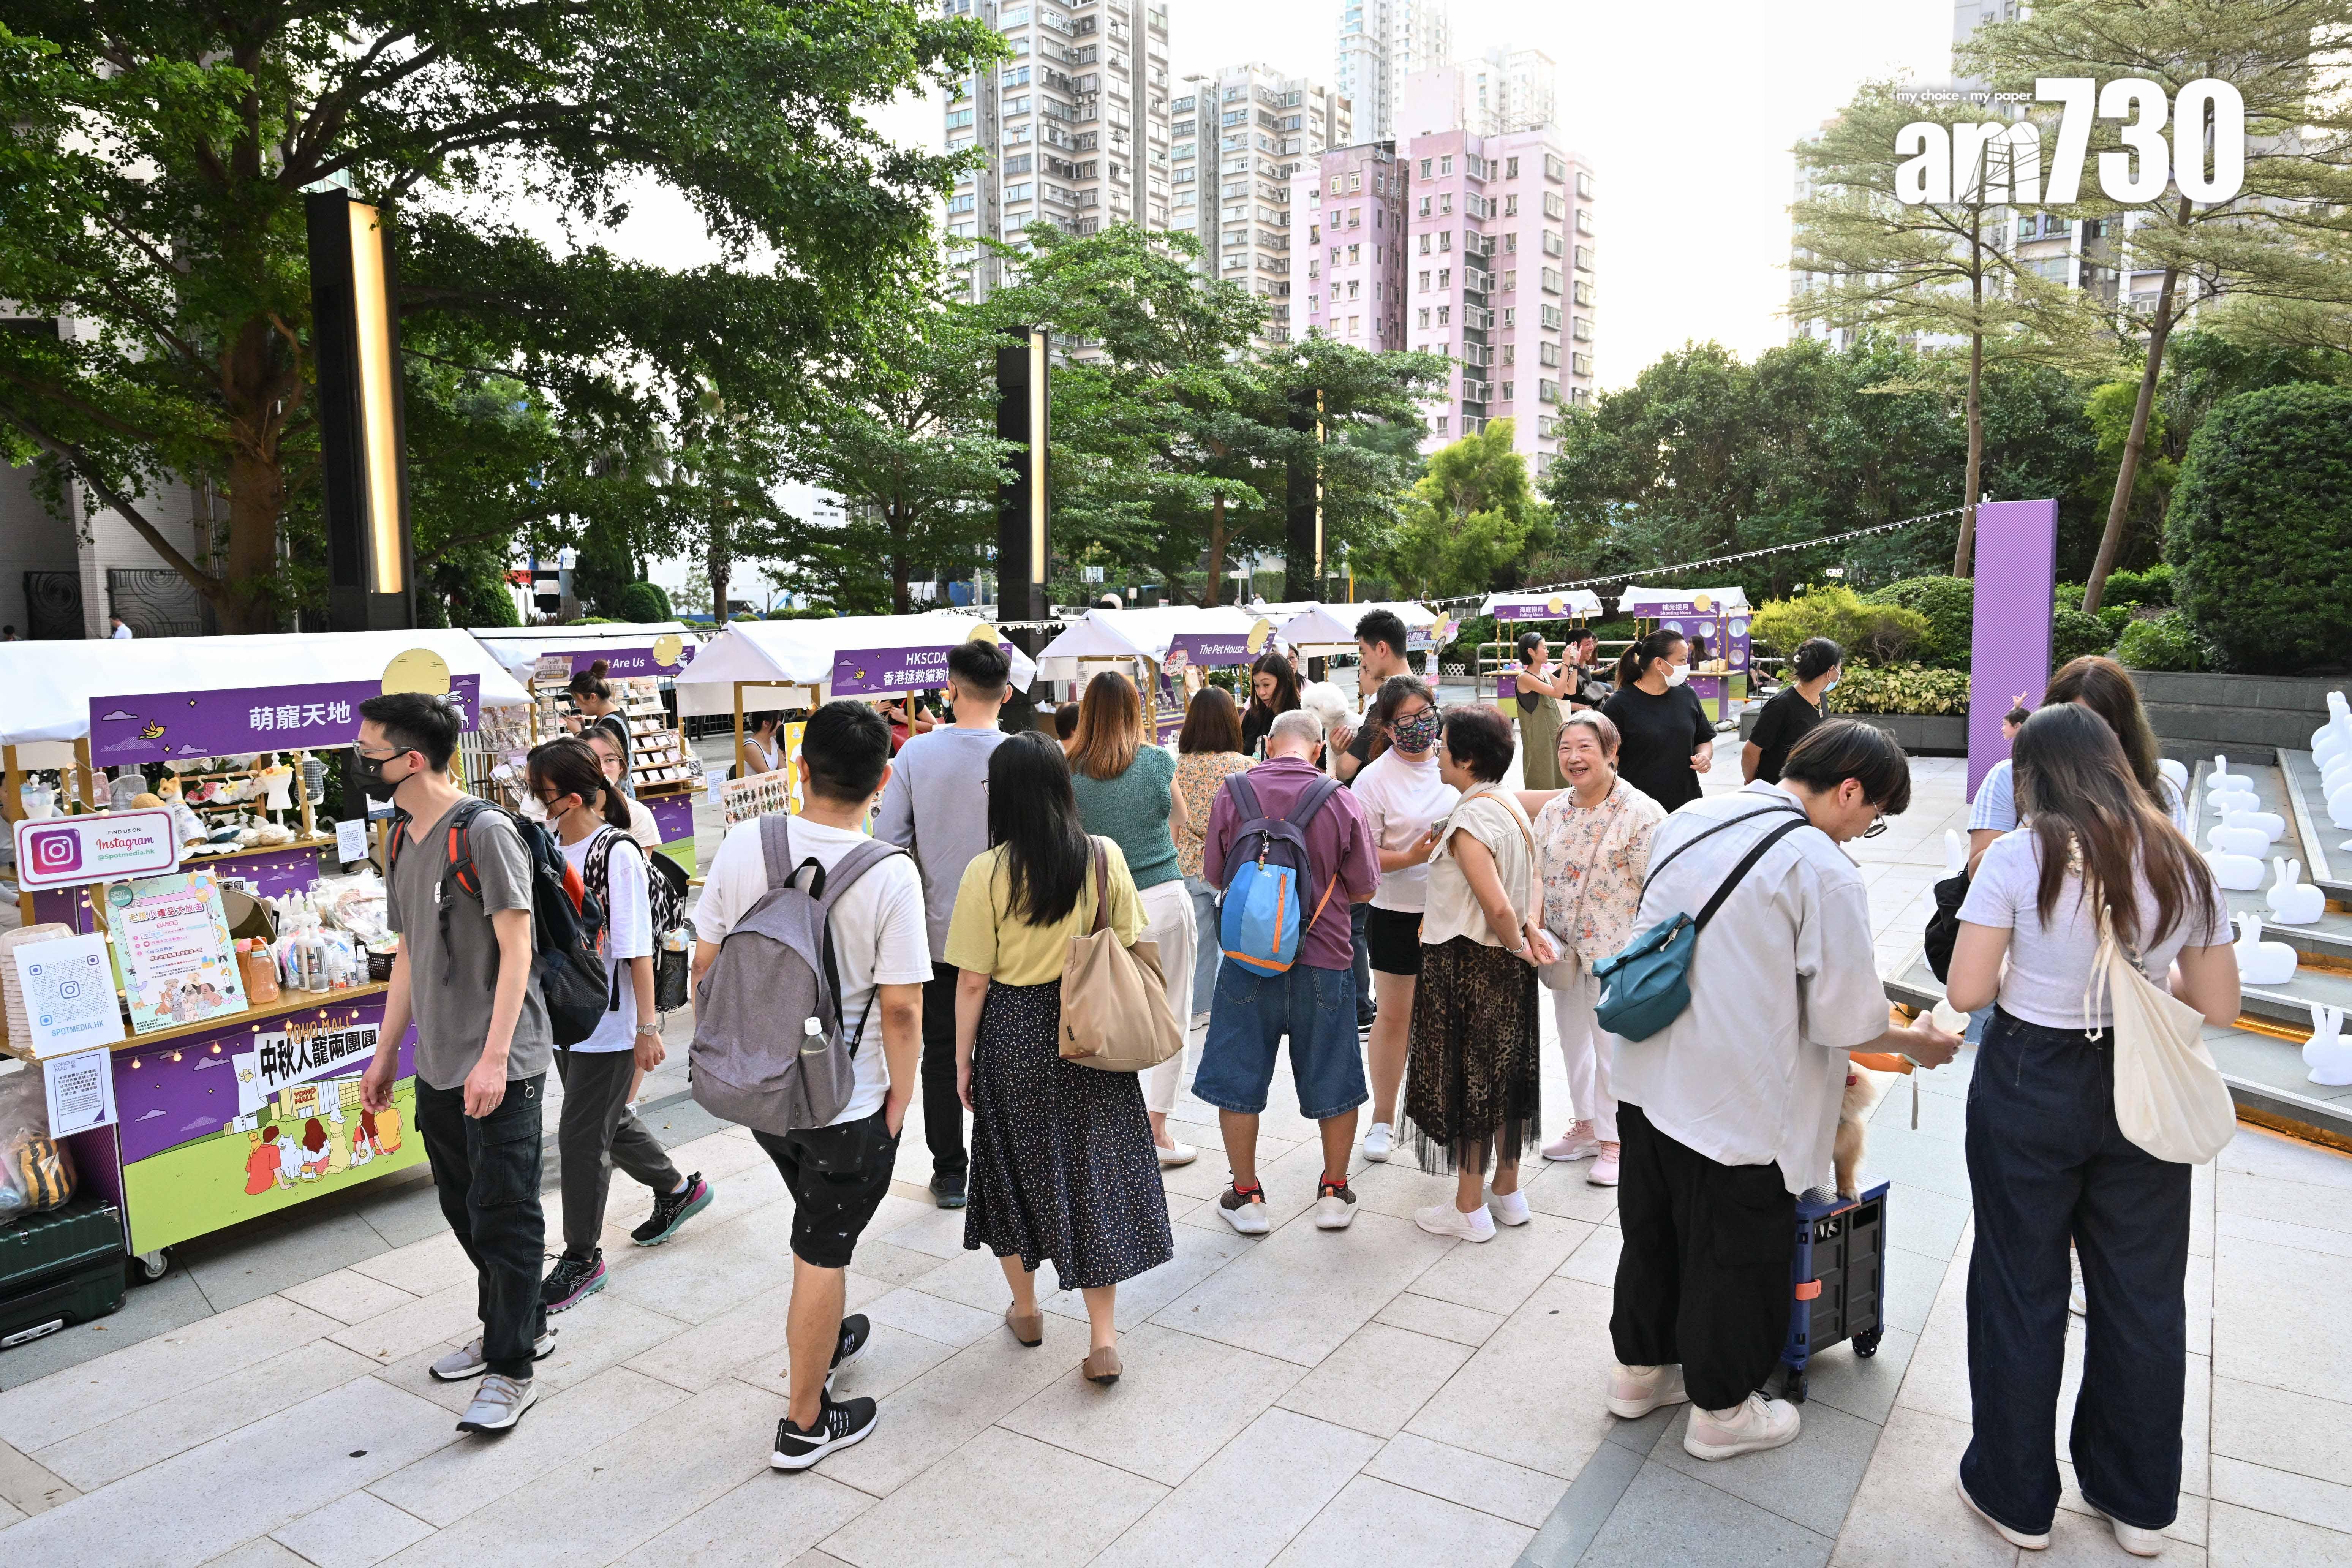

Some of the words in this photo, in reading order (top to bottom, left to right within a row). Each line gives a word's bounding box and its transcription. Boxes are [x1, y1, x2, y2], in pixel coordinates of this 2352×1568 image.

[1200, 644, 1212, 655] The
[1212, 644, 1224, 654] Pet
[1223, 644, 1244, 654] House
[612, 659, 630, 669] Are
[632, 657, 645, 667] Us
[906, 651, 947, 665] HKSCDA
[249, 700, 351, 731] 萌寵天地
[96, 837, 154, 851] Instagram
[97, 849, 155, 861] @Spotmedia.hk
[128, 902, 204, 922] 毛孩小禮品大放送
[51, 1020, 104, 1037] SPOTMEDIA.HK
[286, 1021, 318, 1045] YOHO
[321, 1015, 353, 1036] MALL
[260, 1029, 377, 1086] 中秋人寵兩團圓
[294, 1087, 316, 1098] YOHO
[295, 1094, 315, 1105] MALL
